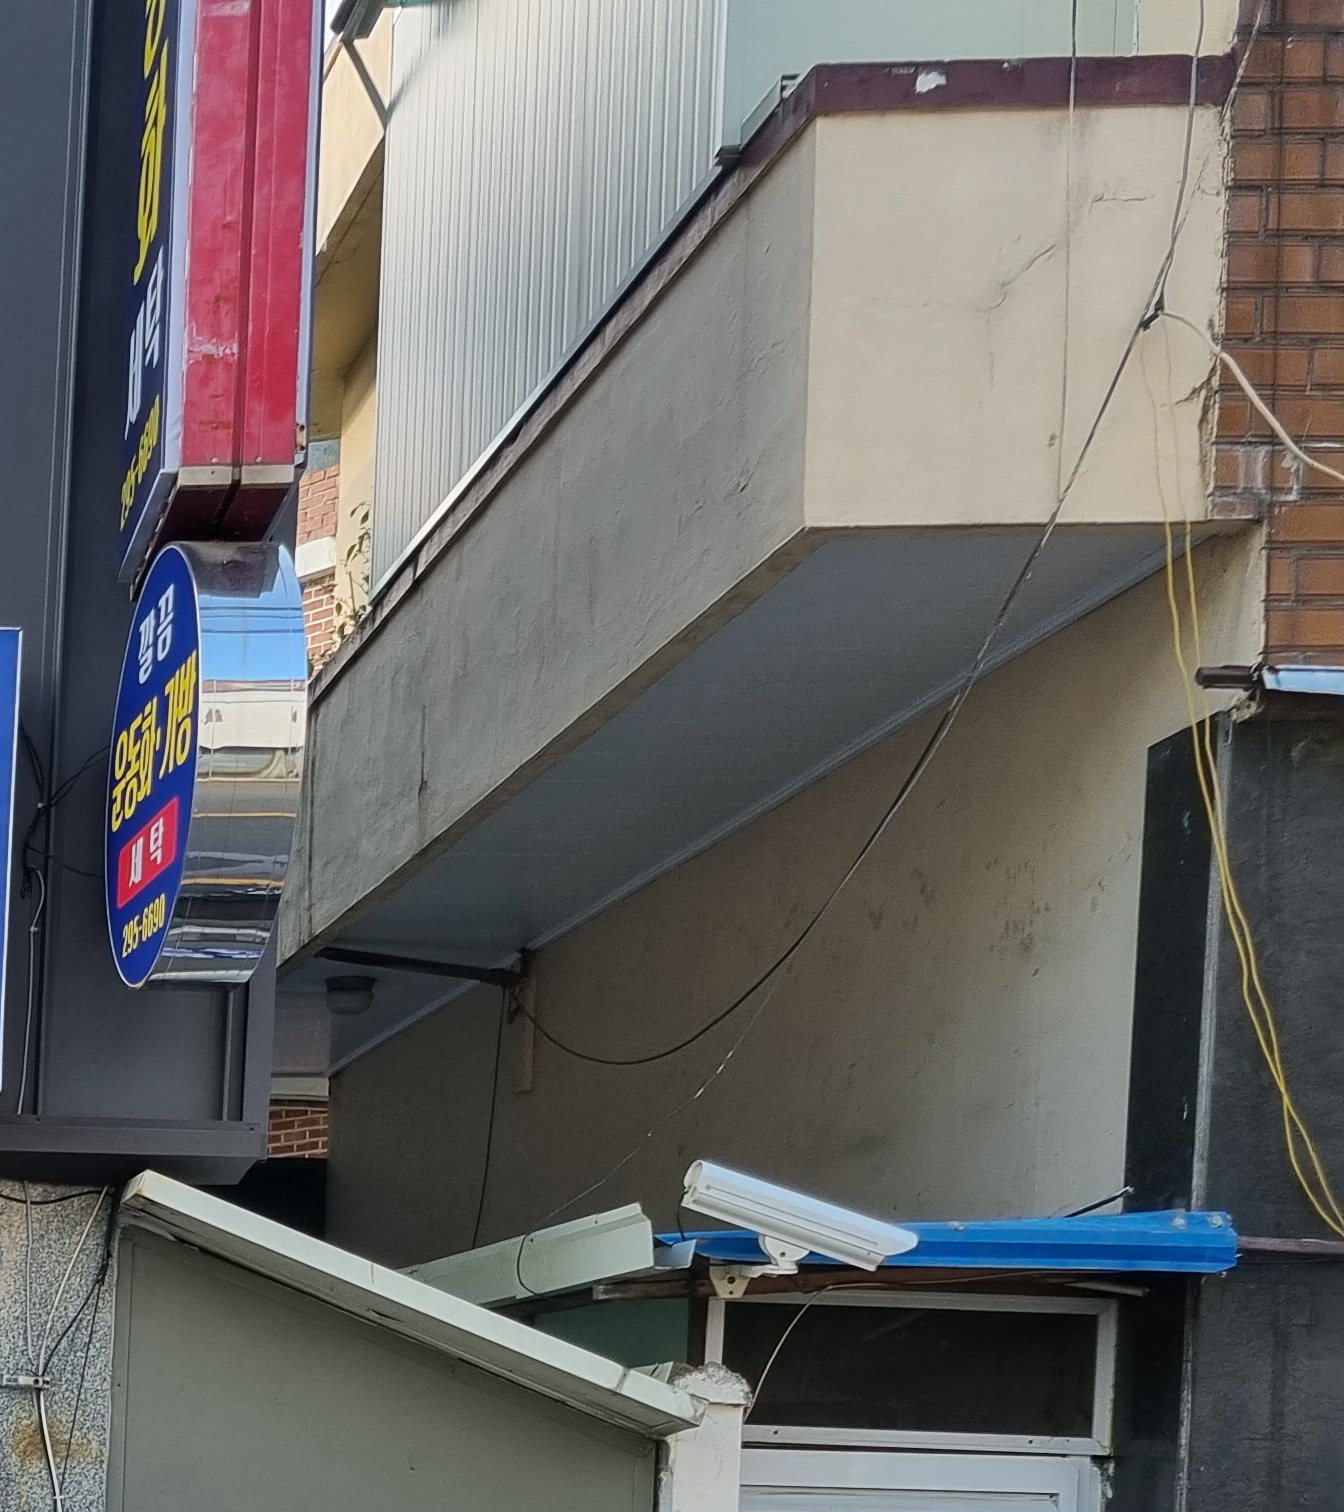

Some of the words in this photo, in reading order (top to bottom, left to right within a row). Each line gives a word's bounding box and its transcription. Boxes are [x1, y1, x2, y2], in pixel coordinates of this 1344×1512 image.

[137, 583, 176, 686] 깔끔
[128, 816, 166, 888] 세탁
[121, 891, 166, 958] 295-6690
